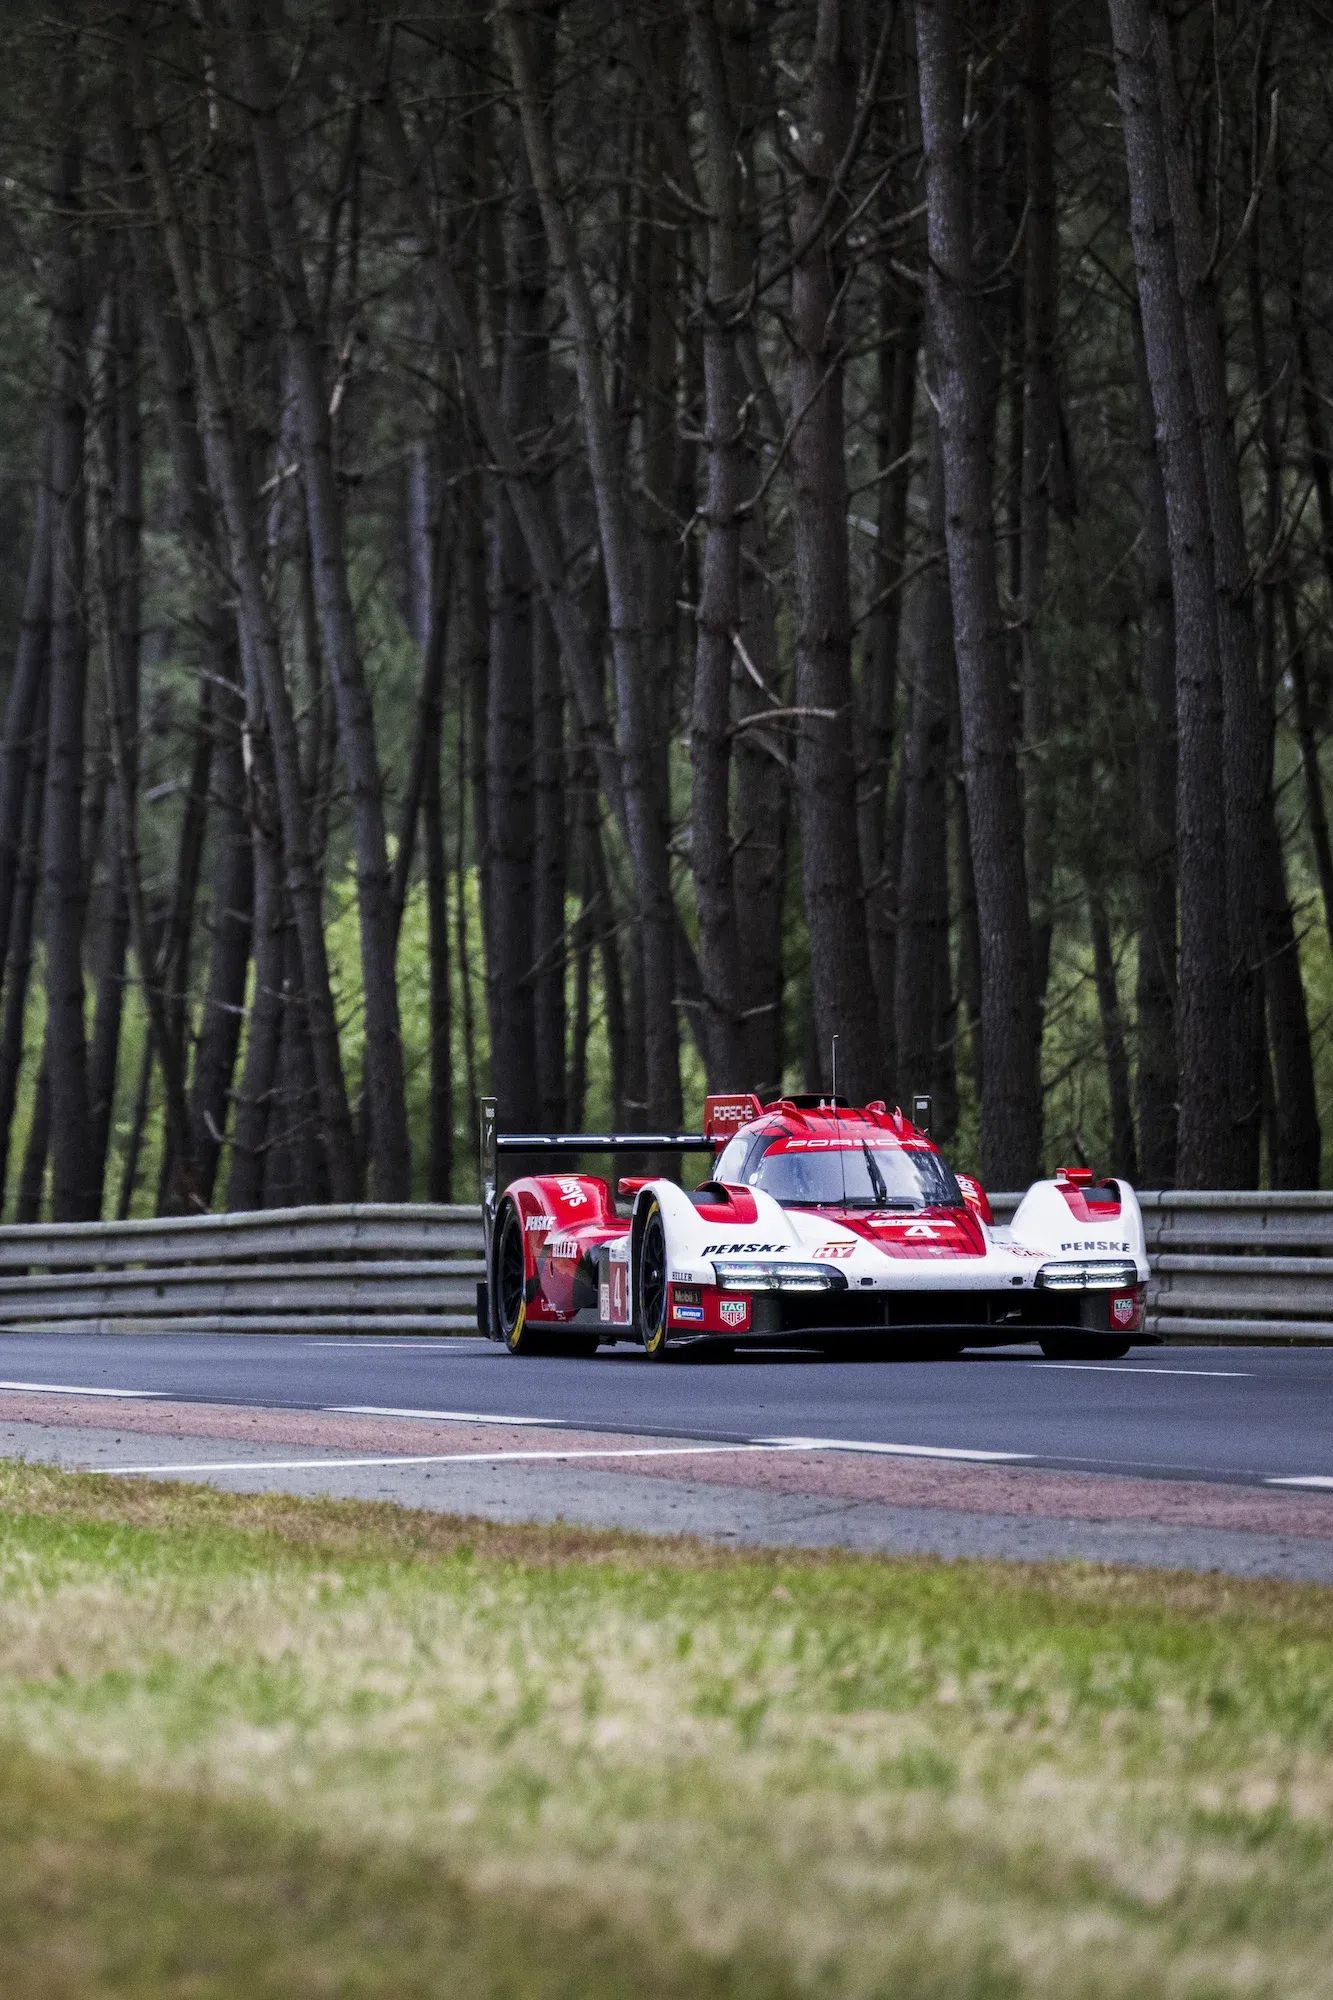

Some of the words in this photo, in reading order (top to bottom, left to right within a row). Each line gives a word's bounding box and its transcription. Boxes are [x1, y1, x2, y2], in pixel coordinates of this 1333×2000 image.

[714, 1104, 753, 1121] PORSCHE
[786, 1137, 930, 1148] PORSCHE
[525, 1215, 557, 1231] PENSKE
[904, 1225, 941, 1239] 4
[701, 1243, 791, 1257] PENSKE
[1061, 1241, 1130, 1253] PENSKE
[613, 1267, 622, 1317] 4
[722, 1303, 744, 1312] TAG
[1115, 1300, 1132, 1309] TAG
[721, 1311, 745, 1324] HEUER
